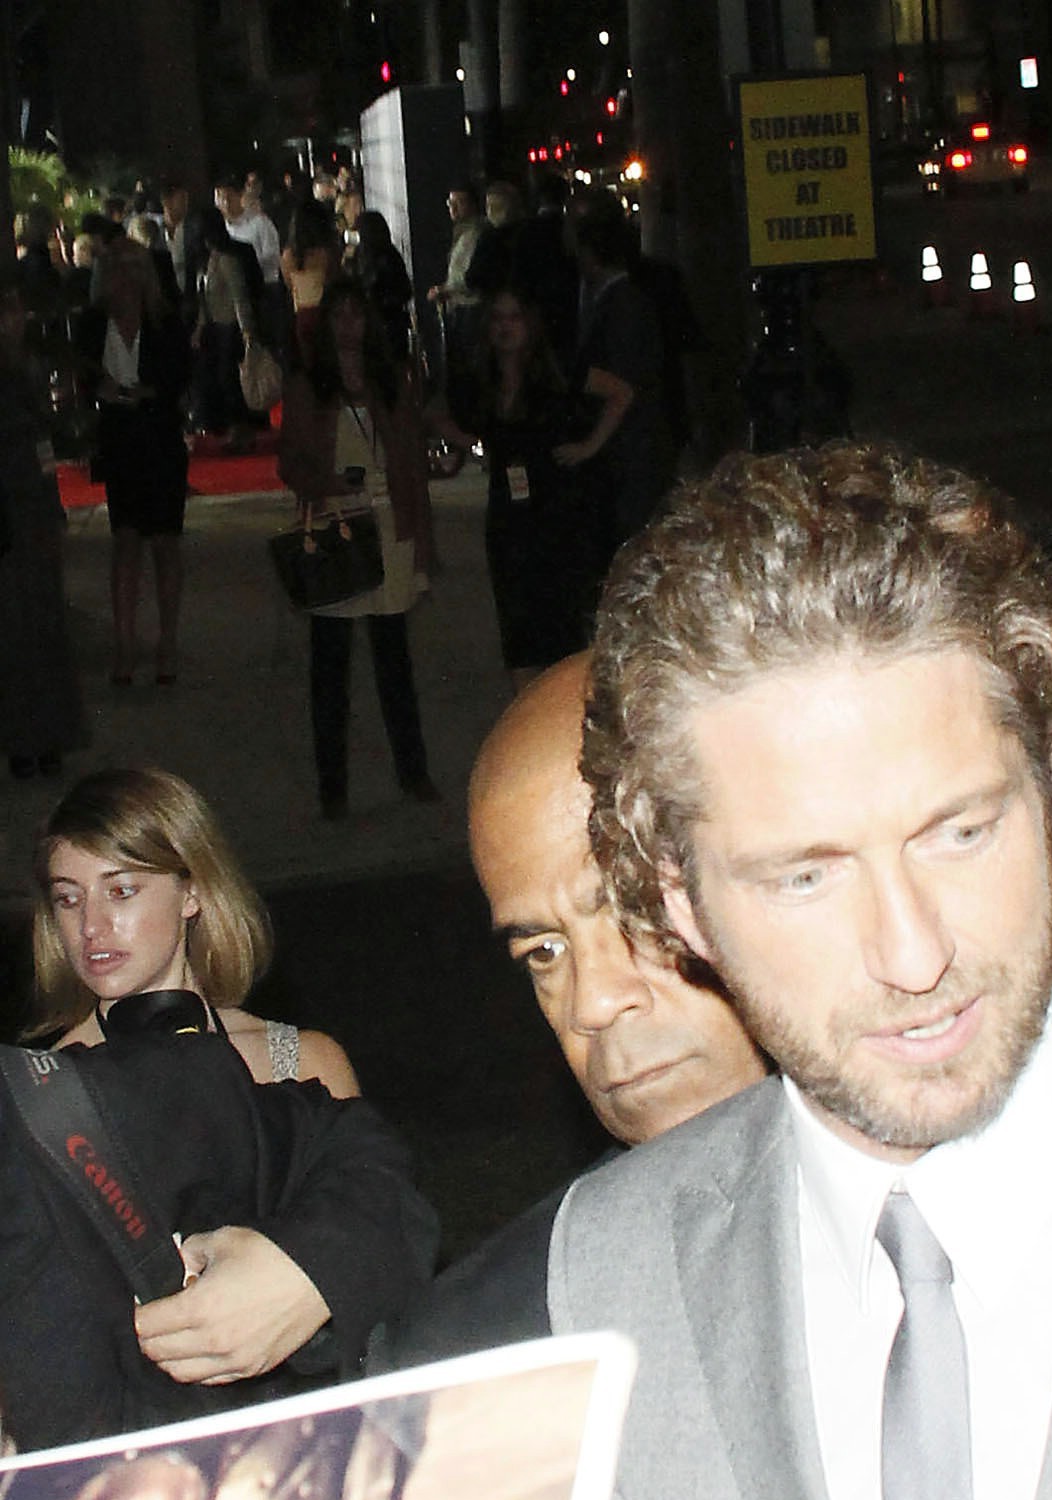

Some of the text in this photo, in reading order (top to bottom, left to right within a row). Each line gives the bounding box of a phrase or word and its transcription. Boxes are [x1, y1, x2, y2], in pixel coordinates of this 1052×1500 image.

[751, 113, 860, 140] SIDEWALK
[767, 147, 846, 173] CLOSED
[796, 182, 820, 205] AT
[765, 214, 856, 241] THEATRE
[66, 1135, 146, 1239] Canon
